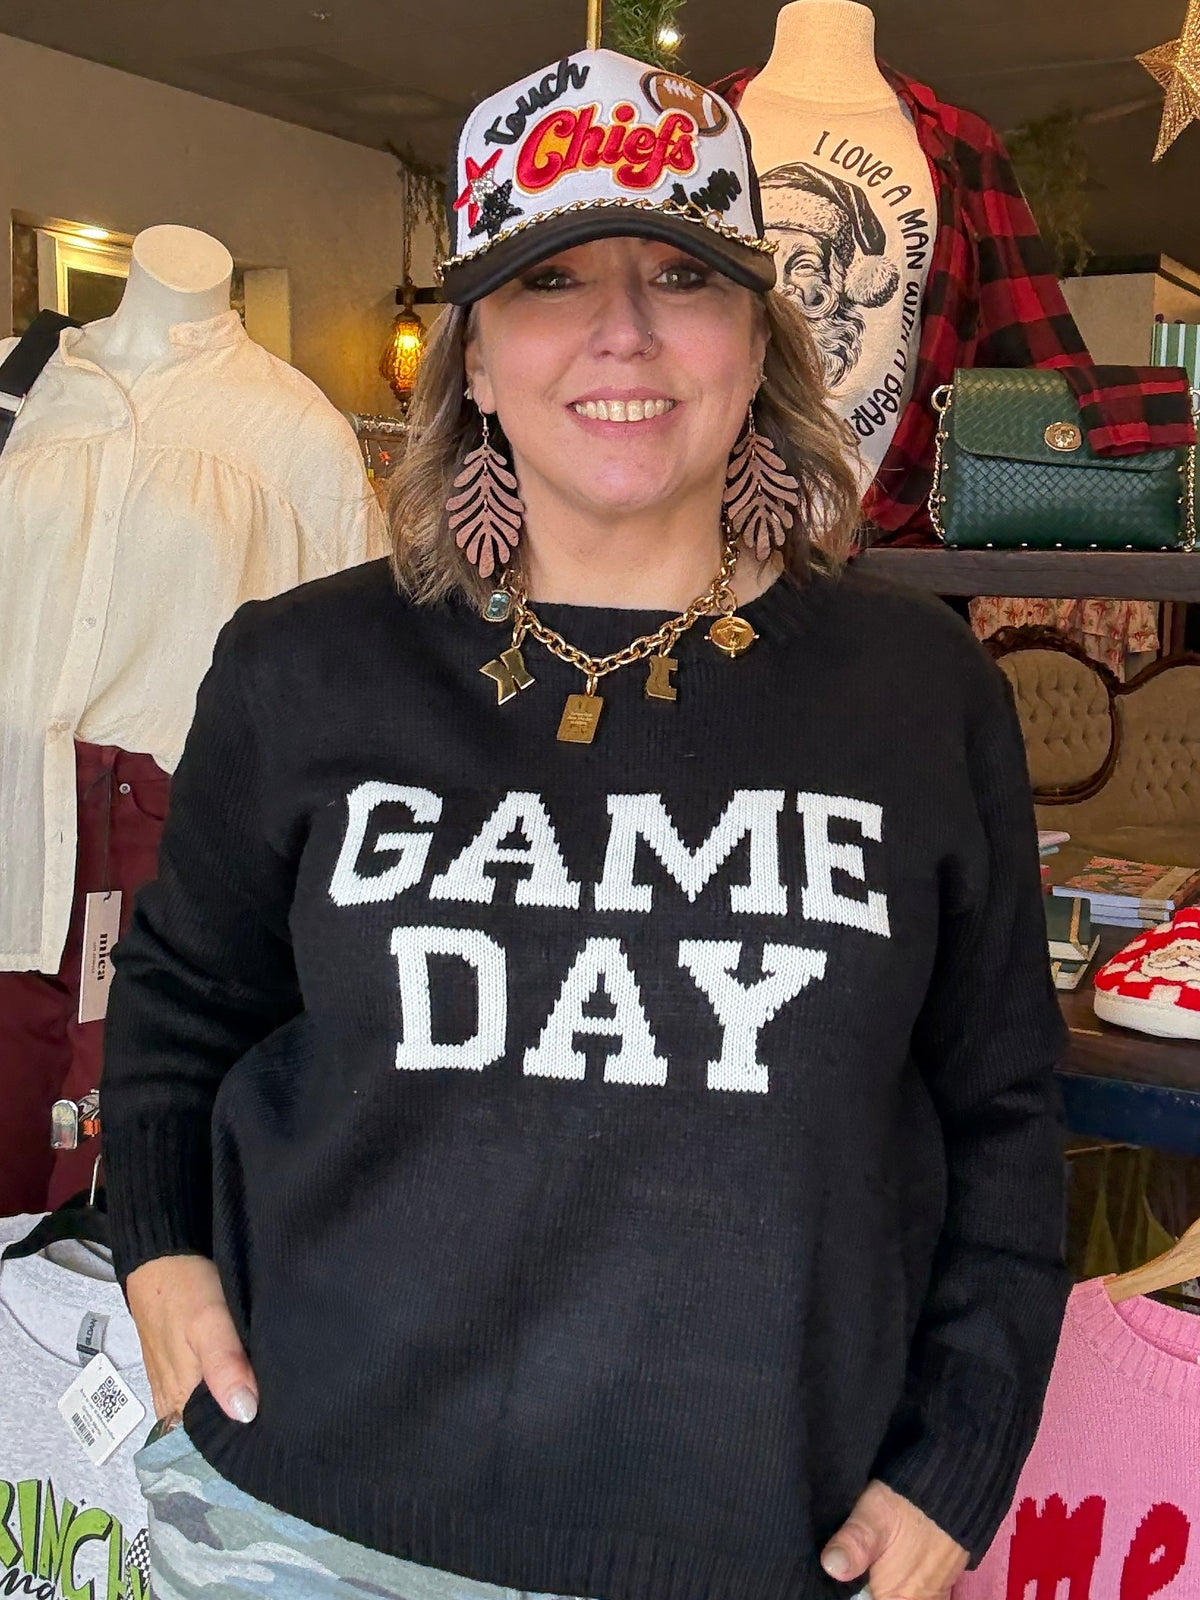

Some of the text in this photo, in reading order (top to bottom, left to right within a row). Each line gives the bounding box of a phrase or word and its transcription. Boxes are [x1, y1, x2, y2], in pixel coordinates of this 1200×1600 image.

[515, 103, 697, 190] Chiefs
[813, 131, 830, 156] I
[882, 185, 912, 207] A
[897, 208, 929, 269] MAN
[328, 780, 891, 938] GAME
[97, 933, 110, 980] mica
[390, 925, 827, 1093] DAY
